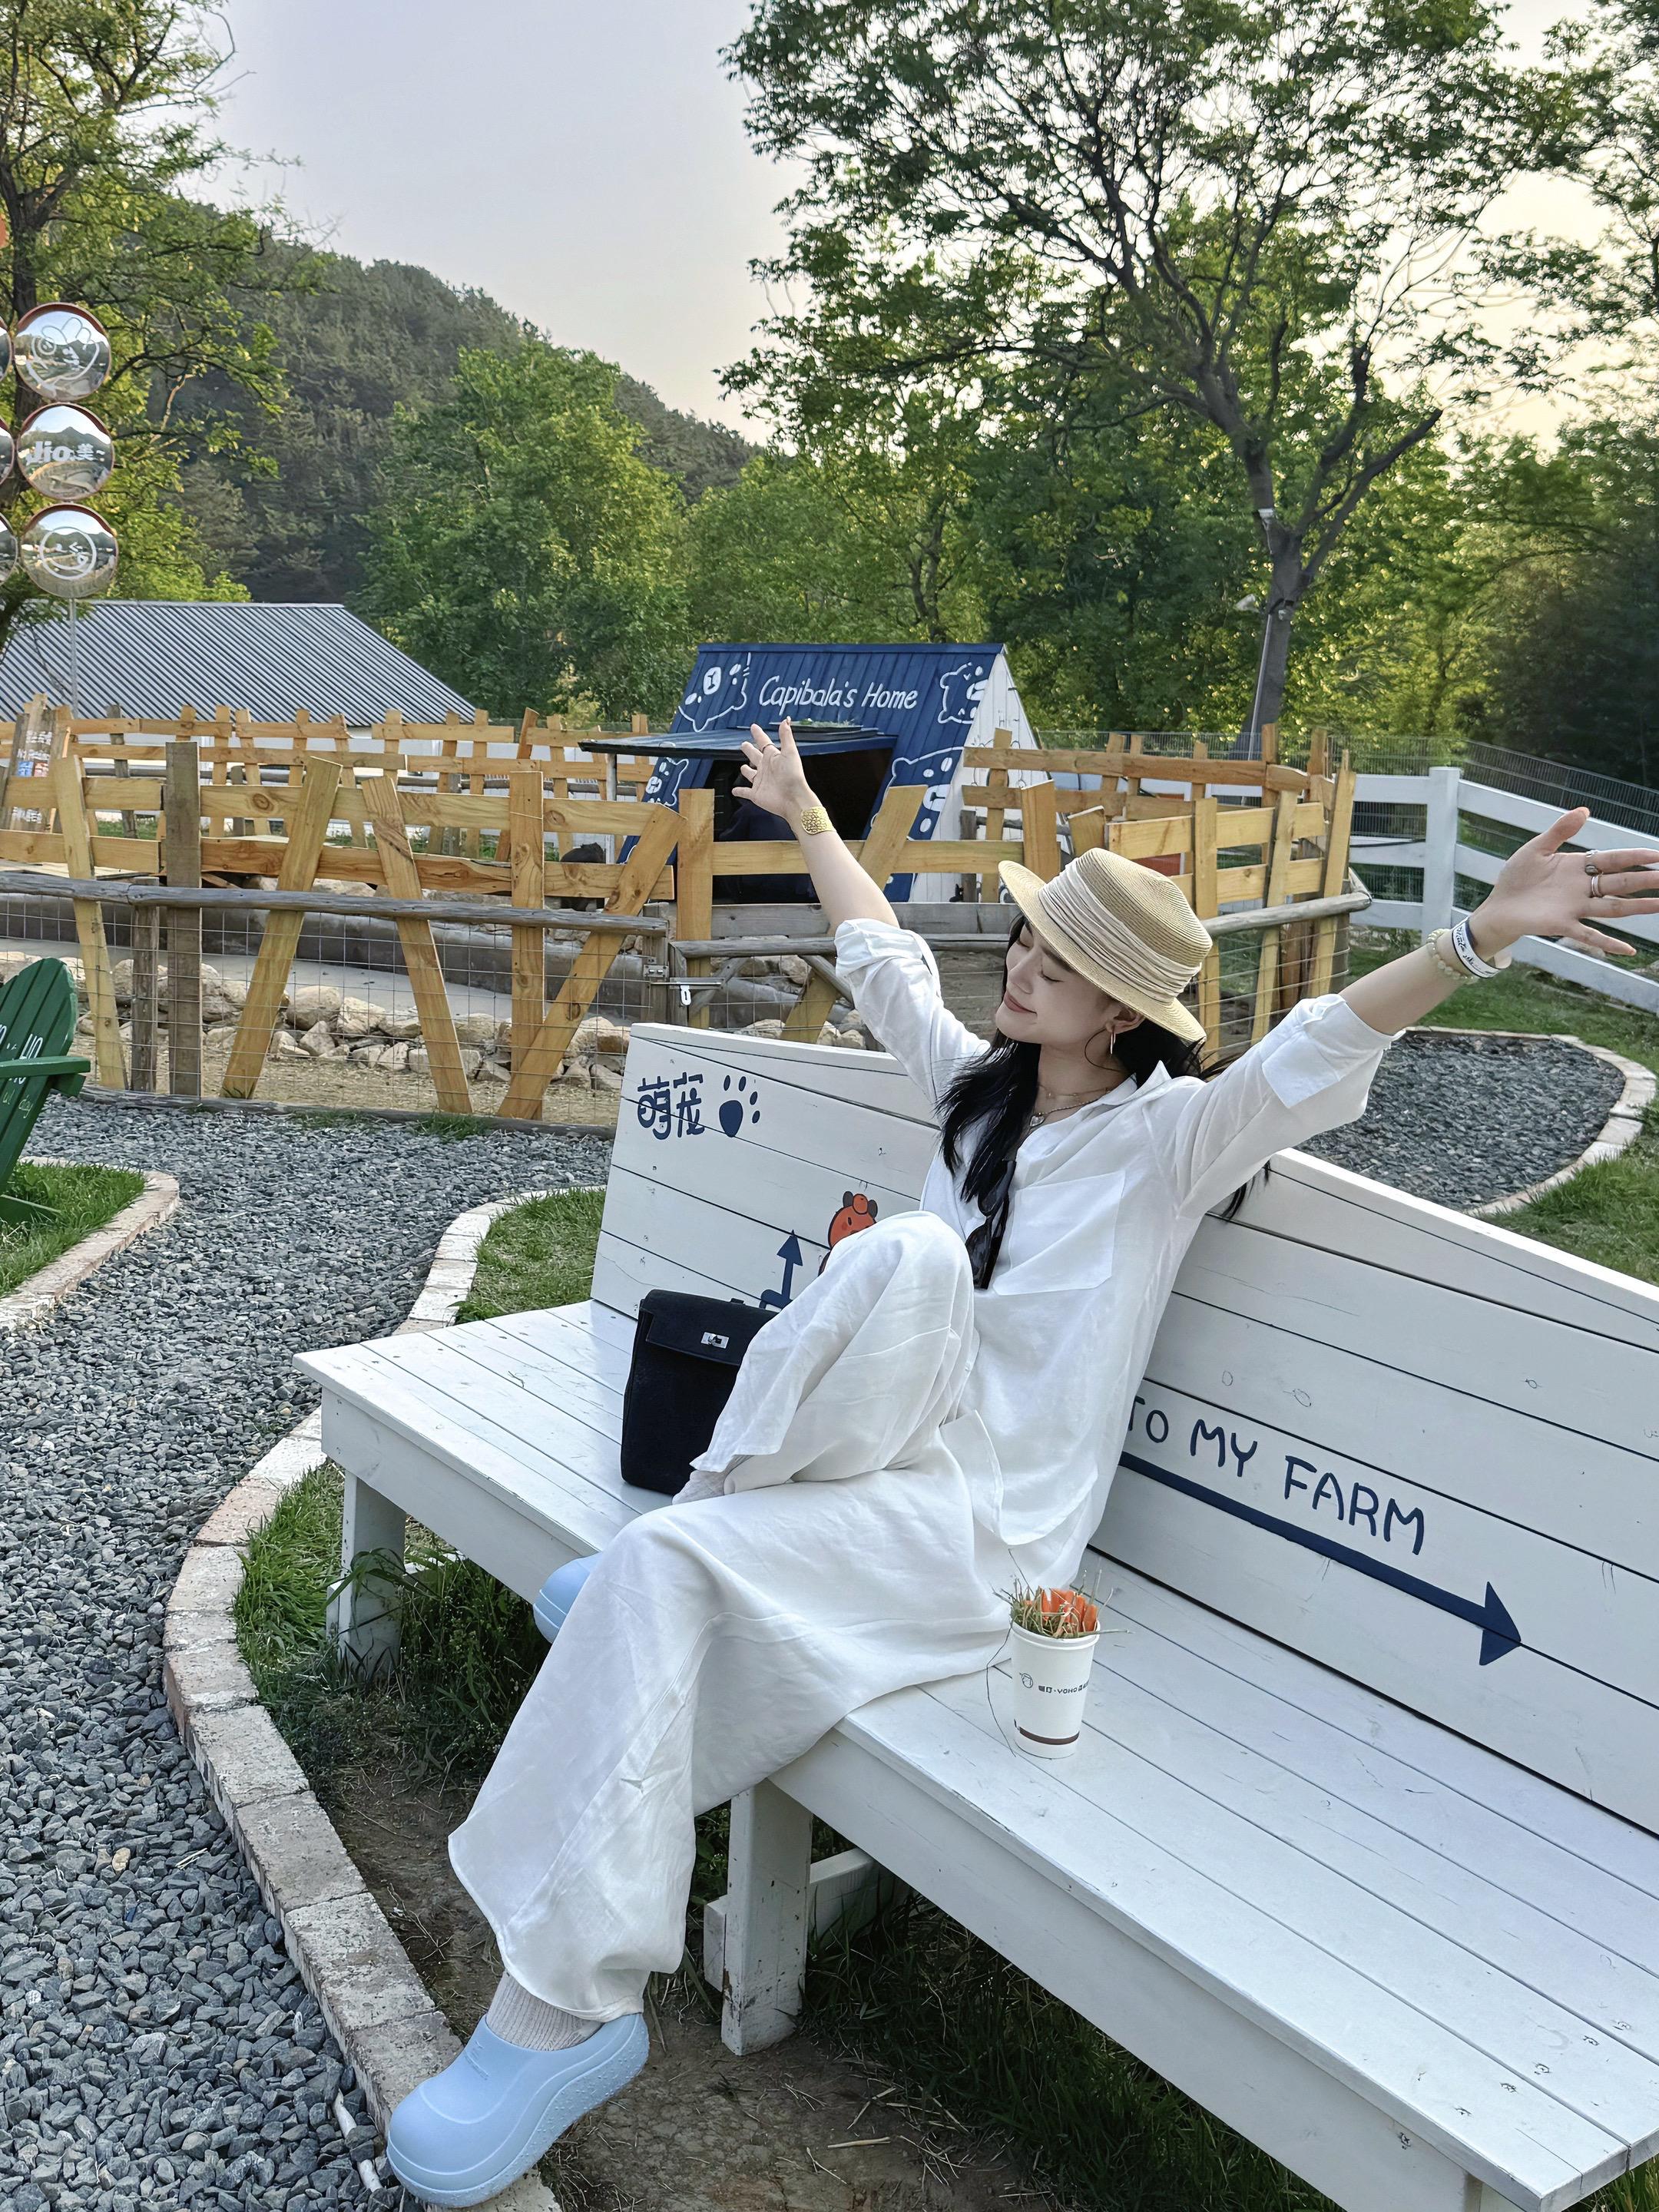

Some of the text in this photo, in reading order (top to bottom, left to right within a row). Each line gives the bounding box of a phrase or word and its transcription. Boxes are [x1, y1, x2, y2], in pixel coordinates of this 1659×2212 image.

[758, 675, 919, 716] Capibala's Home
[1128, 1396, 1425, 1555] TO MY FARM
